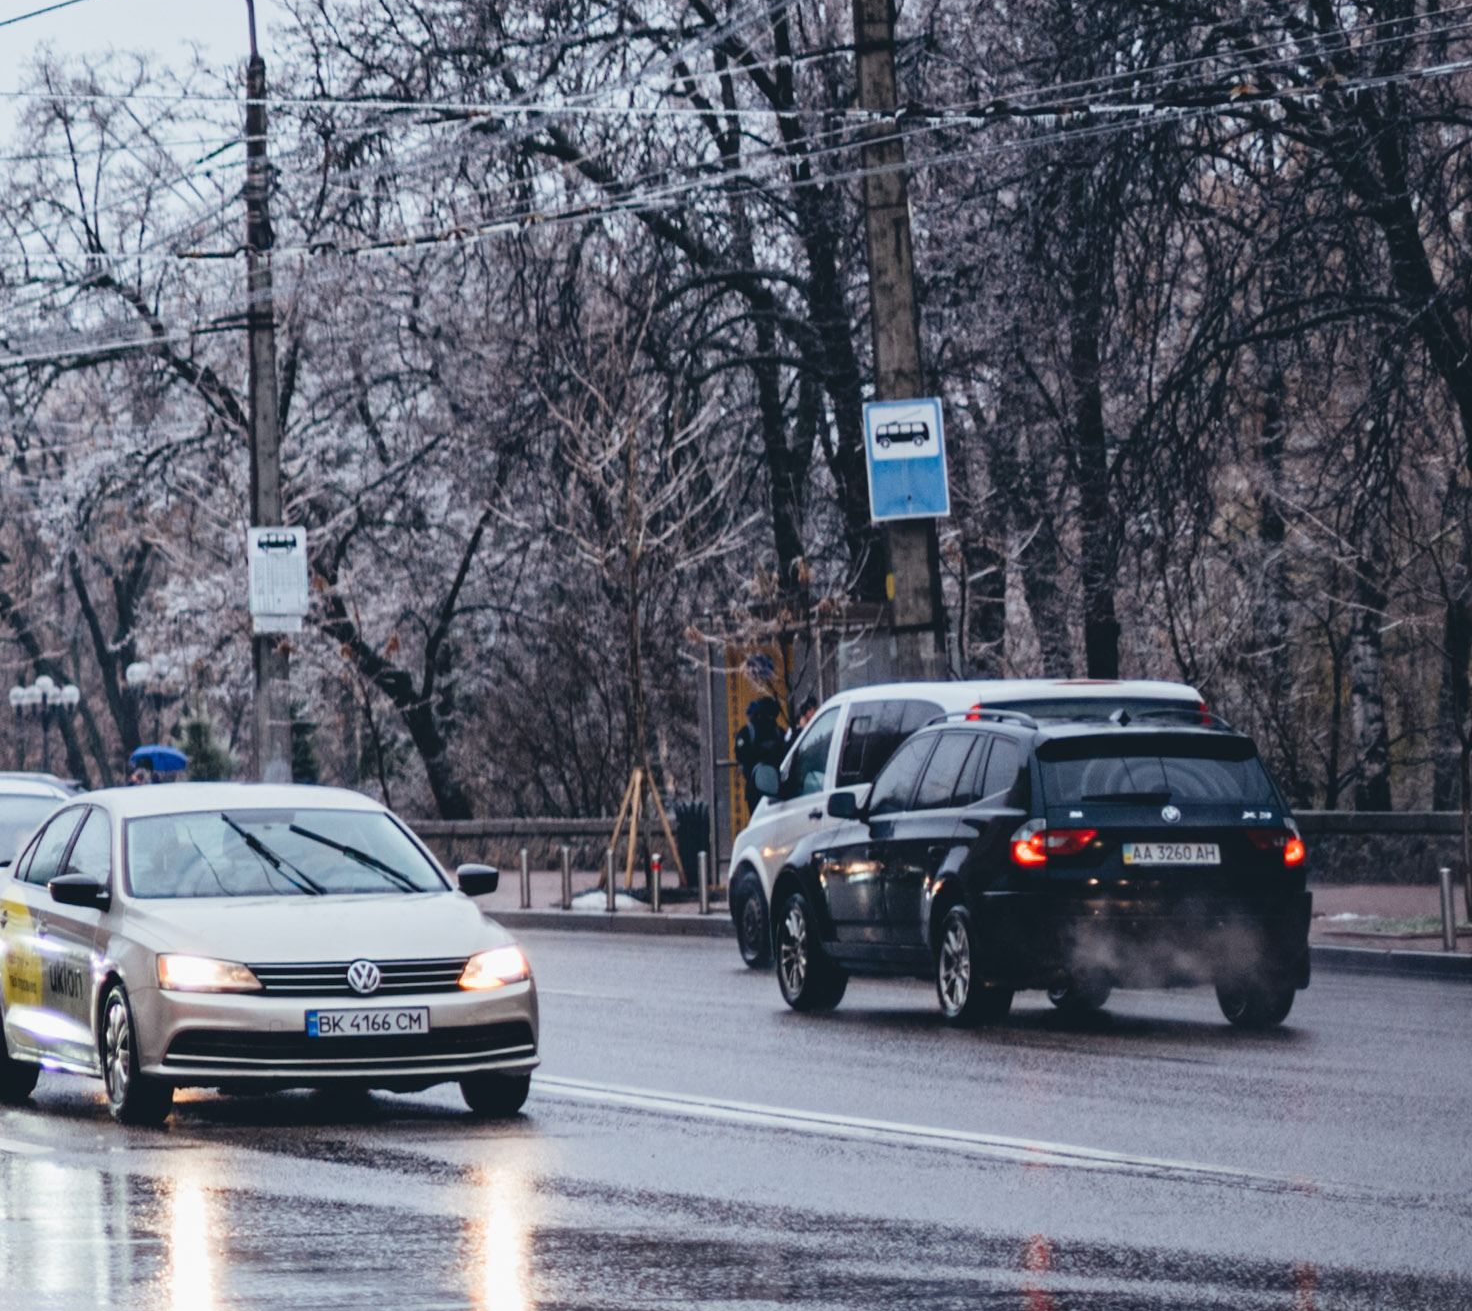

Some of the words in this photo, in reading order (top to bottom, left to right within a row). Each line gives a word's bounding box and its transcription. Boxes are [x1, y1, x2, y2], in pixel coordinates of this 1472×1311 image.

[1133, 845, 1153, 860] AA
[1158, 846, 1192, 860] 3260
[1196, 846, 1216, 860] AH
[49, 957, 83, 999] uklon
[318, 1015, 345, 1033] BK
[350, 1013, 391, 1032] 4166
[395, 1012, 422, 1031] CM
